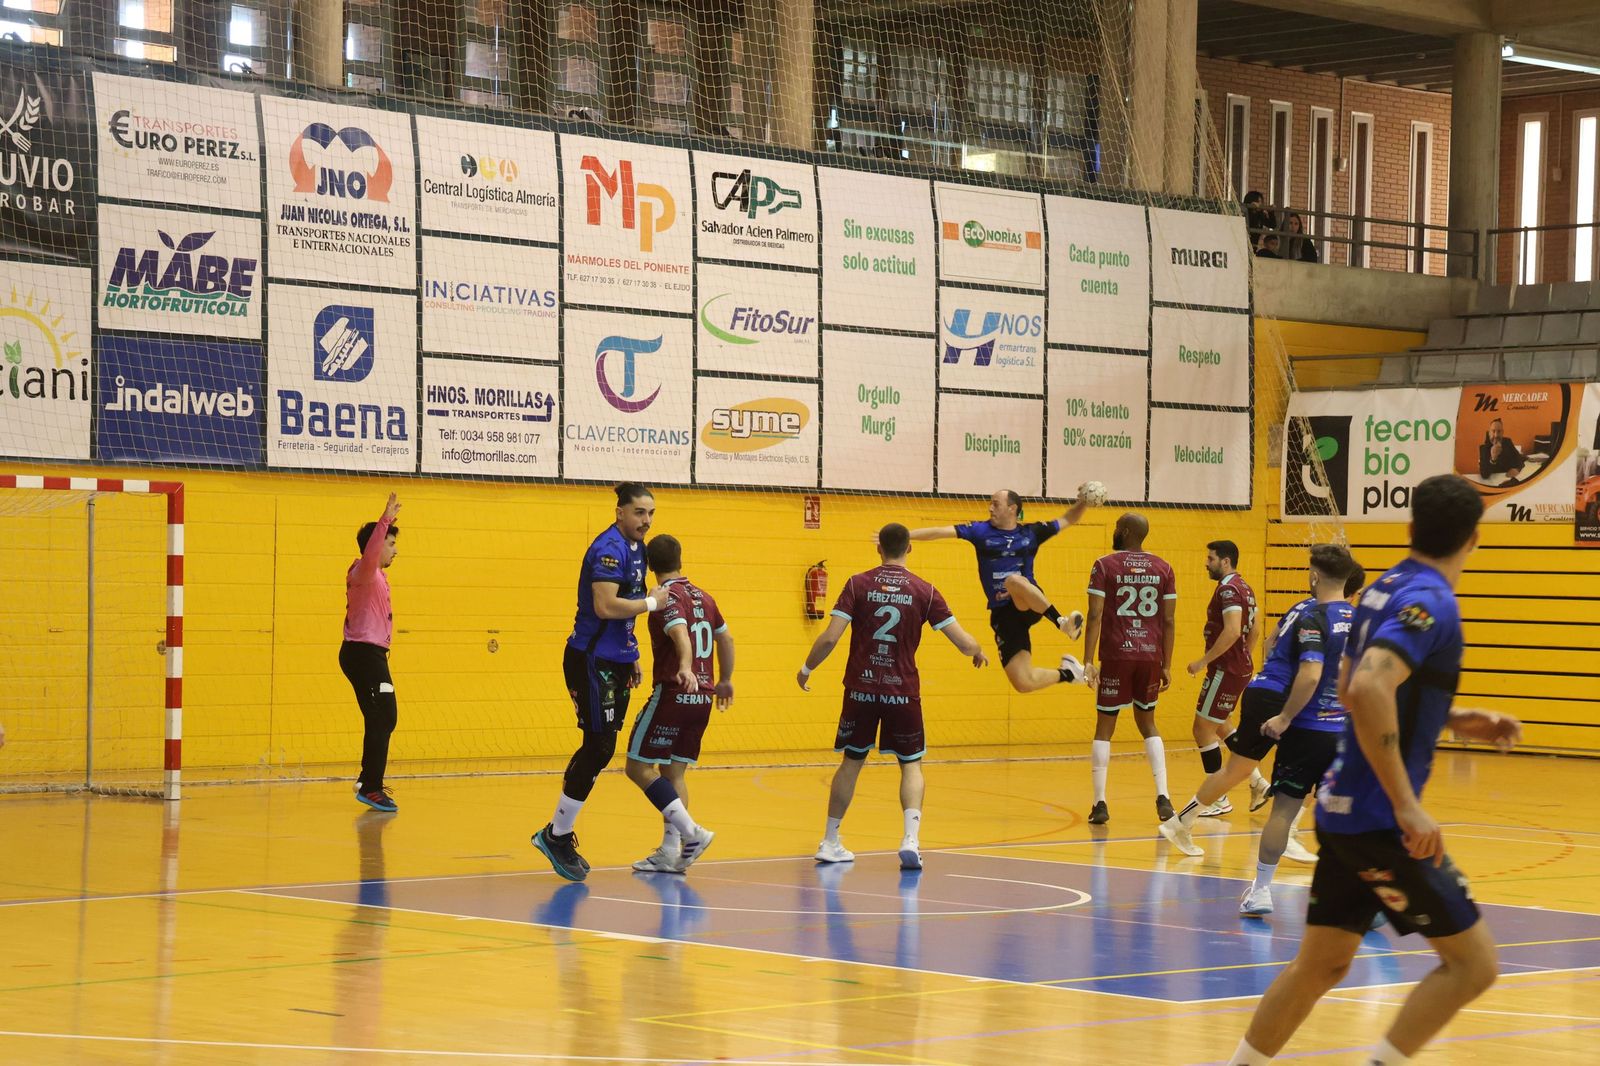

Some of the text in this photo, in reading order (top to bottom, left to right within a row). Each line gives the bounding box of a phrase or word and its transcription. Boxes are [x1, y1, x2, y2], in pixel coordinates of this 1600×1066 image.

[132, 115, 239, 141] TRANSPORTES
[183, 136, 241, 160] PEREZ
[157, 157, 220, 171] WWW.EUROPEREZ.ES
[146, 169, 228, 184] TRAFICO@EUROPEREZ.COM
[316, 166, 368, 200] JNO
[424, 179, 556, 208] Central Logística Almería
[280, 203, 411, 233] JUAN NICOLAS ORTEGA, S.L.
[276, 224, 411, 248] TRANSPORTES NACIONALES
[701, 219, 744, 235] Salvador
[775, 228, 814, 243] Palmero
[843, 219, 915, 245] Sin excusas
[293, 240, 395, 257] E INTERNACIONALES
[1068, 243, 1130, 269] Cada punto
[1170, 247, 1229, 269] MURGI
[107, 247, 258, 302] MABE
[623, 259, 642, 271] DEL
[643, 262, 690, 275] PONIENTE
[842, 252, 917, 276] solo actitud
[580, 274, 590, 283] 627
[1080, 279, 1119, 296] cuenta
[103, 292, 249, 317] HORTOFRUTICOLA
[424, 300, 557, 319] CONSULTING PRODUCING TRADING
[730, 307, 815, 334] FitoSur
[1179, 345, 1221, 368] Respeto
[0, 358, 89, 401] iani
[105, 375, 255, 418] indalweb
[427, 385, 544, 410] HNOS. MORILLAS
[857, 383, 901, 410] Orgullo
[1501, 392, 1549, 403] MERCADER
[277, 389, 409, 441] Baena
[451, 409, 521, 421] TRANSPORTES
[1066, 398, 1130, 420] 10% talento
[566, 424, 690, 446] CLAVEROTRANS
[711, 408, 801, 439] syme
[861, 415, 896, 441] Murgi
[1365, 415, 1451, 442] tecno
[323, 442, 363, 454] Seguridad
[371, 443, 410, 456] Cerrajeros
[438, 429, 541, 445] Telf: 0034 958 981 077
[964, 432, 1021, 457] Disciplina
[1063, 427, 1132, 449] 90% corazón
[441, 448, 538, 465] info@tmorillas.com
[573, 443, 682, 457] Nacional Internacional
[1173, 445, 1224, 464] Velocidad
[1364, 446, 1411, 475] bio
[1362, 480, 1414, 514] pla
[873, 576, 910, 585] TORRES
[867, 590, 913, 606] PÉREZ CHICA
[1116, 585, 1159, 617] 28
[872, 605, 901, 643] 2
[690, 620, 714, 659] 10
